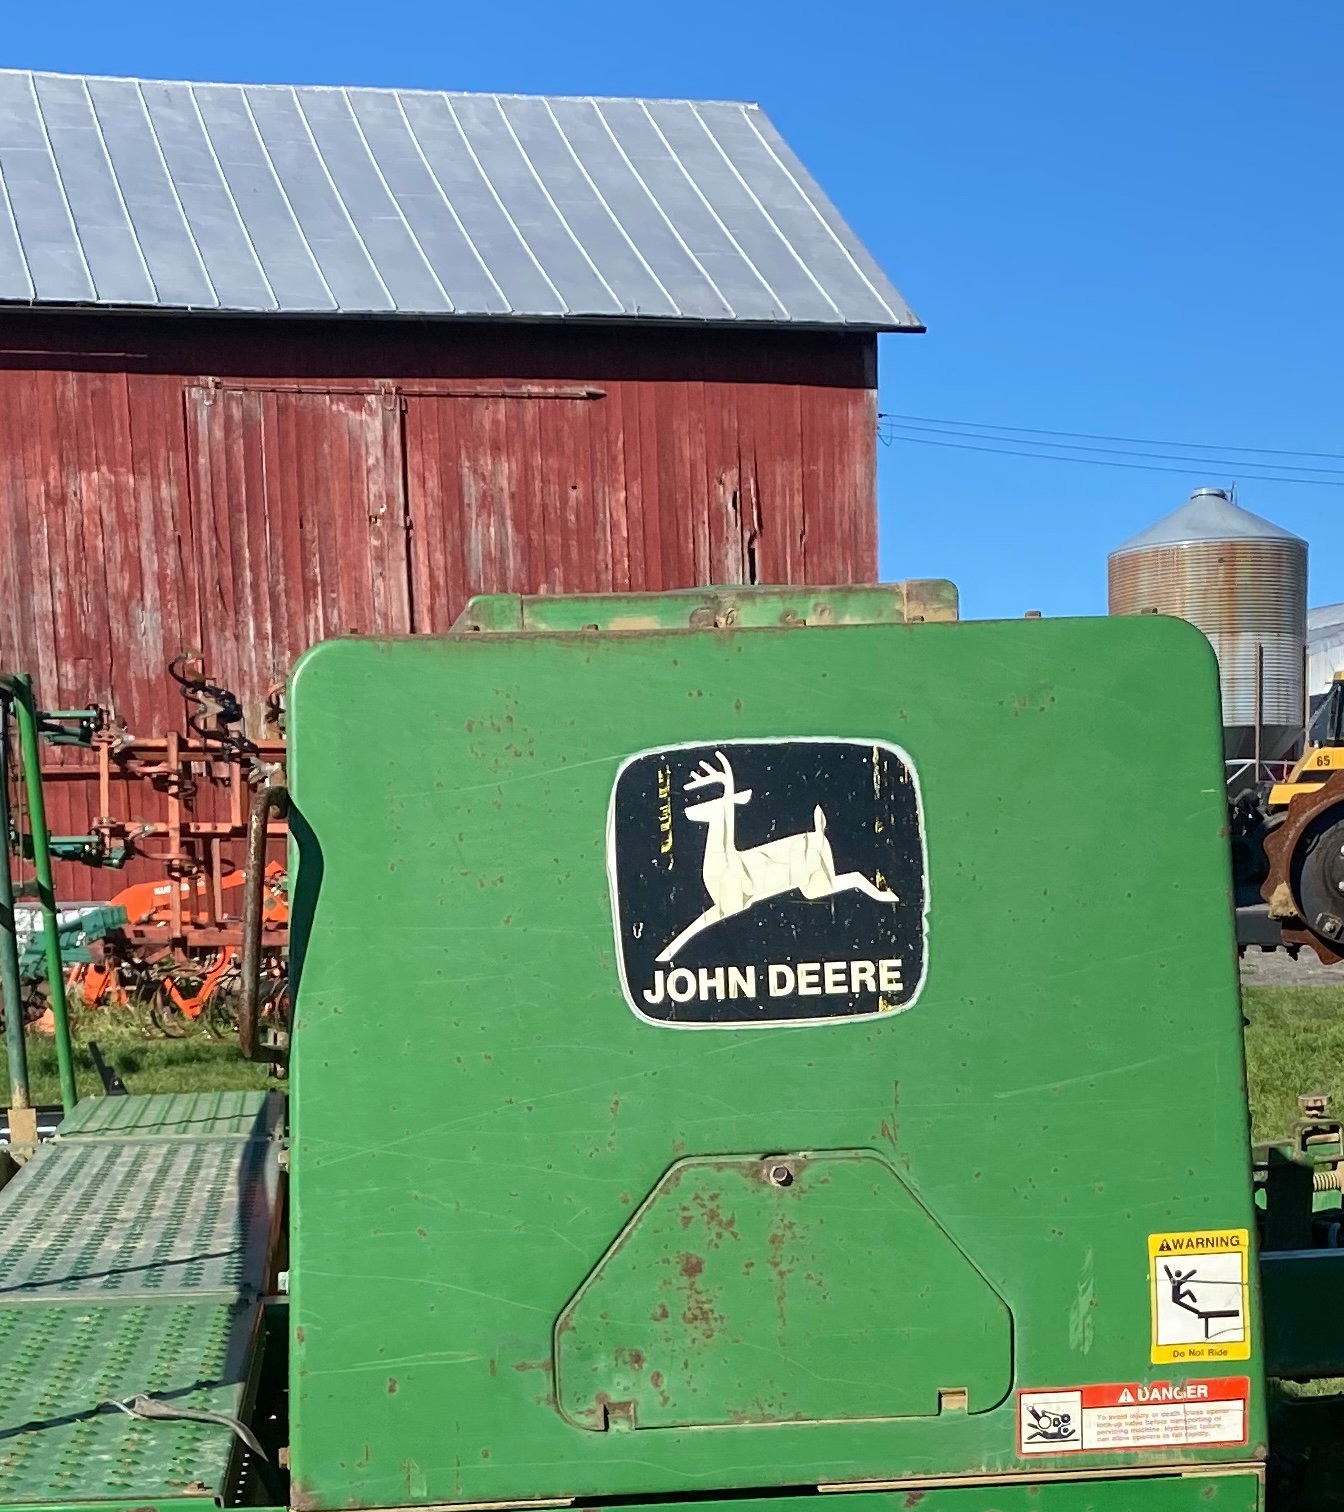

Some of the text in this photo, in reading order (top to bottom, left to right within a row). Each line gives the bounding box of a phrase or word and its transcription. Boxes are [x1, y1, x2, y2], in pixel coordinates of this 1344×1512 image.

[1316, 754, 1331, 768] 65
[642, 958, 904, 1004] JOHN DEERE
[1171, 1235, 1240, 1250] WARNING
[1173, 1350, 1185, 1358] Do
[1208, 1348, 1228, 1357] Ride
[1137, 1384, 1209, 1402] DANGER
